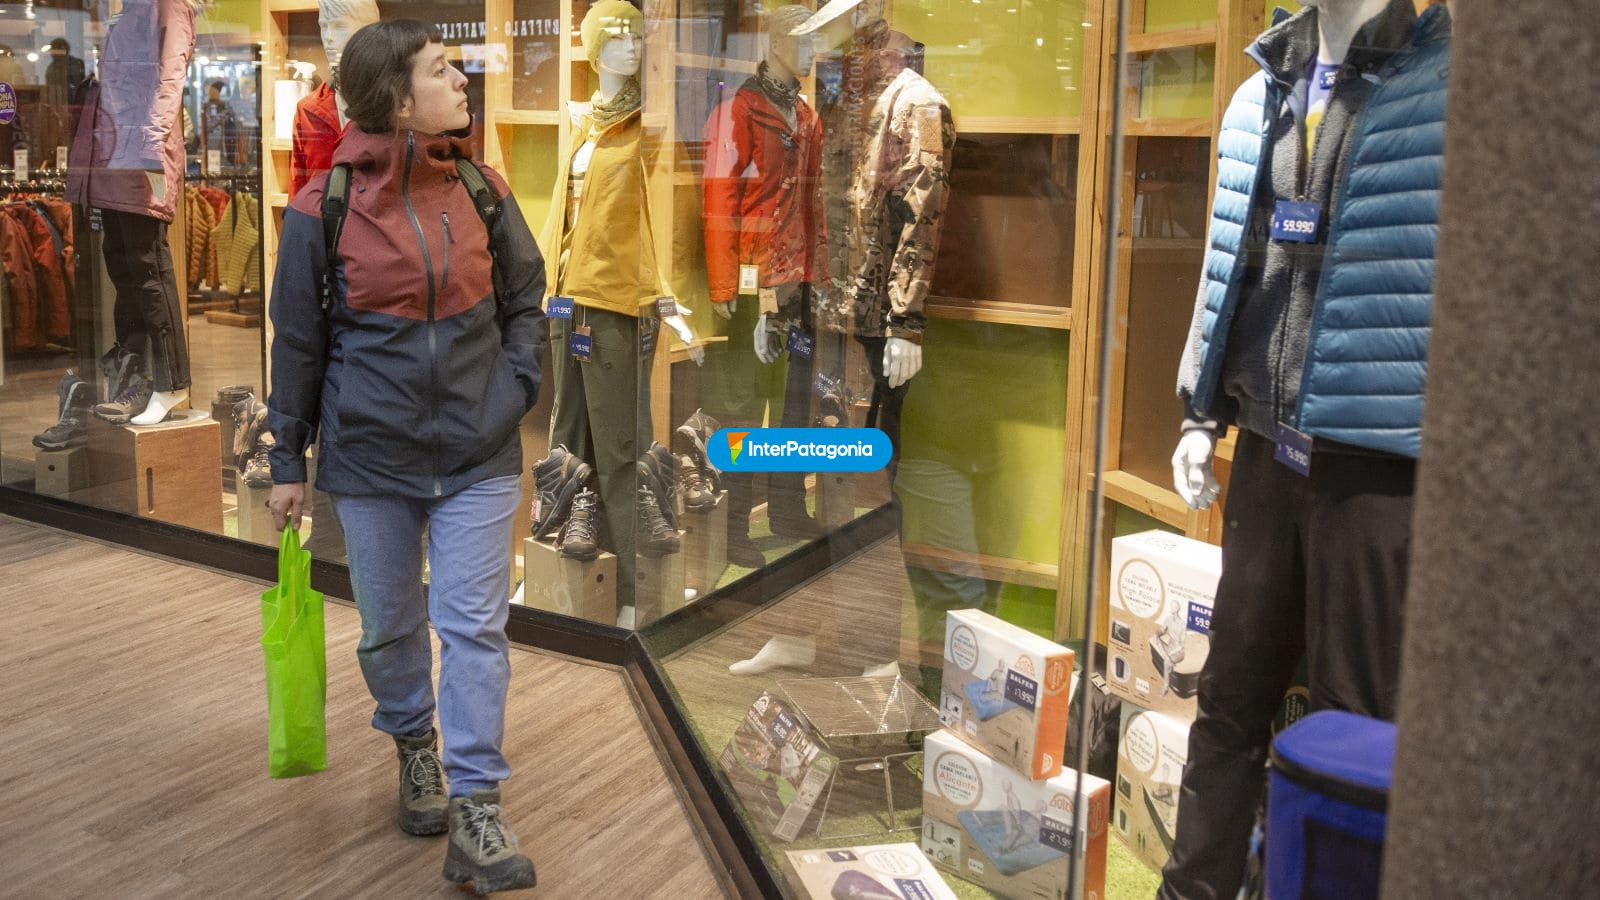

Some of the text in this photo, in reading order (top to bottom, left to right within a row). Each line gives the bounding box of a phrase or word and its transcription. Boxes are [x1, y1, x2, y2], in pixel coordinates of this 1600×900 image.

[1282, 219, 1315, 233] 59.990
[1191, 604, 1213, 617] BALFE
[1194, 616, 1211, 629] 59.9
[1010, 673, 1035, 690] BALFER
[939, 771, 977, 791] Alicante
[1045, 820, 1072, 835] BALFE
[1049, 832, 1073, 849] 27.99
